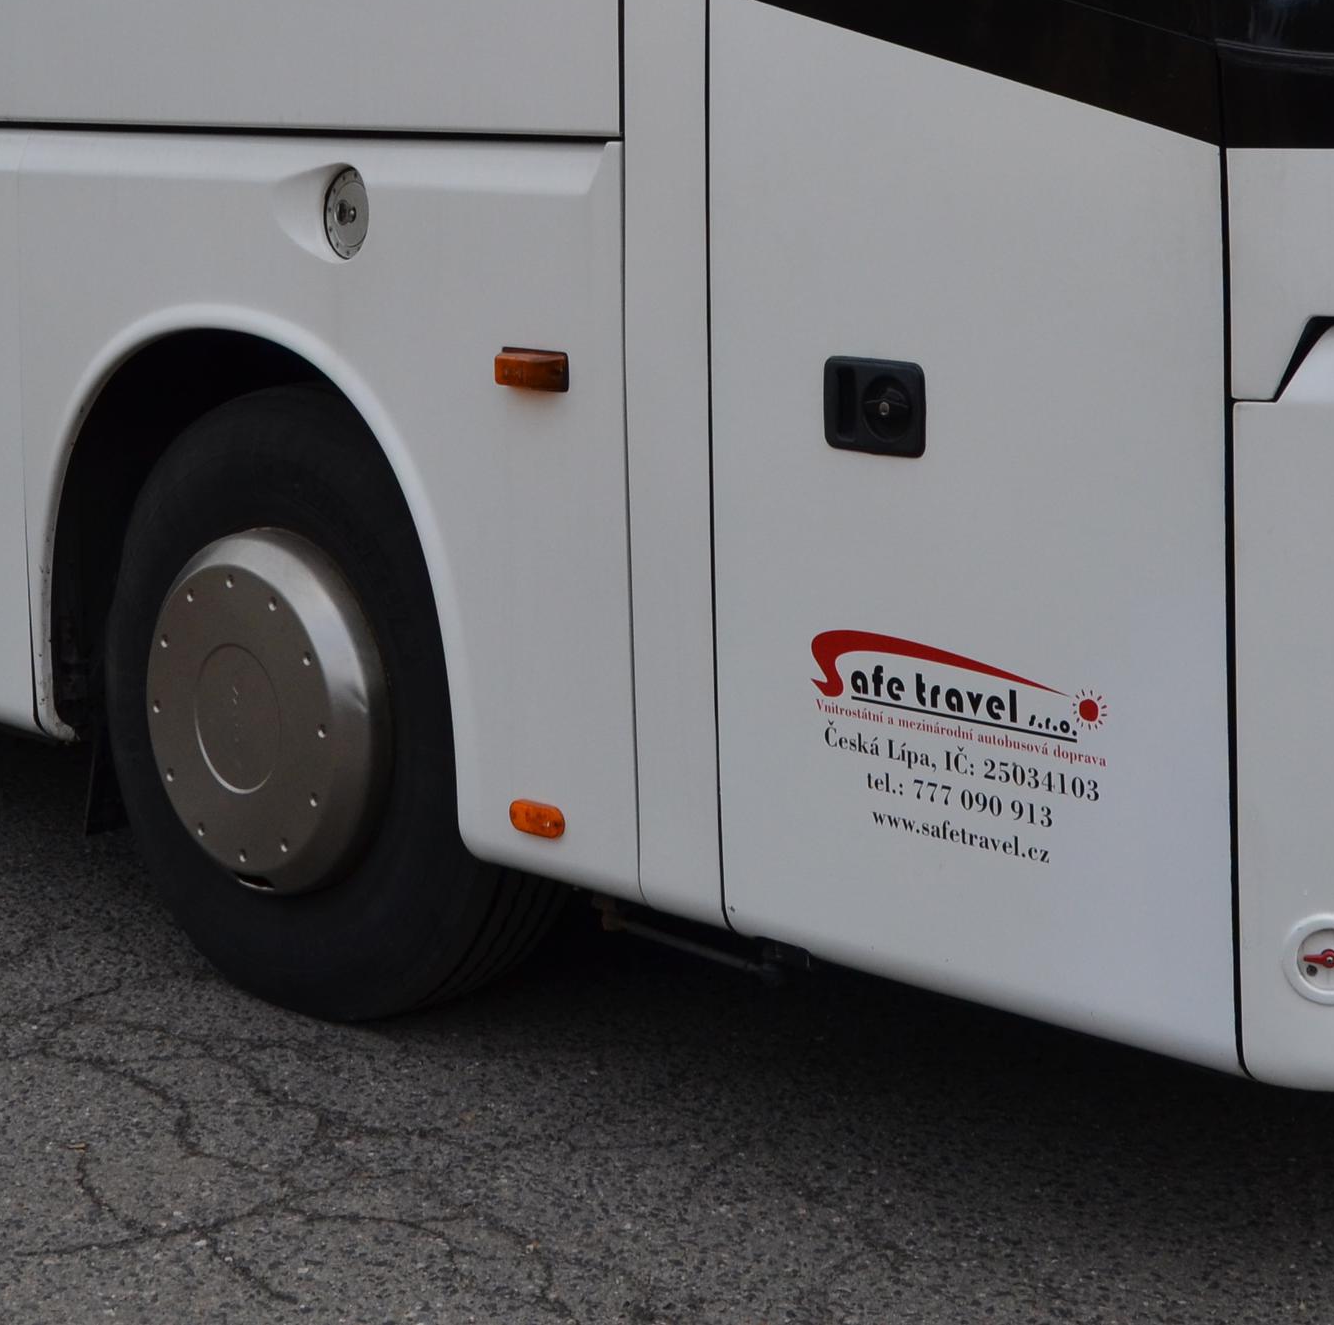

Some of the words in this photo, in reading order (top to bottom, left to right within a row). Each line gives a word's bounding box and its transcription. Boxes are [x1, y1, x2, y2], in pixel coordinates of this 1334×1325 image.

[815, 698, 884, 724] Vnitrostátní
[886, 716, 895, 726] a
[897, 717, 974, 741] mezinárodní
[977, 732, 1049, 756] autobusová
[1053, 744, 1107, 768] doprava
[915, 672, 1018, 724] travel
[1028, 713, 1078, 737] s.r.o.
[824, 720, 880, 757] Česká
[888, 738, 937, 773] Lípa,
[944, 746, 975, 777] IČ:
[983, 758, 1100, 802] 25034103
[867, 772, 904, 797] tel.:
[913, 778, 953, 807] 777
[960, 788, 1003, 818] 090
[1009, 799, 1053, 829] 913
[871, 809, 1050, 864] www.safetravel.cz
